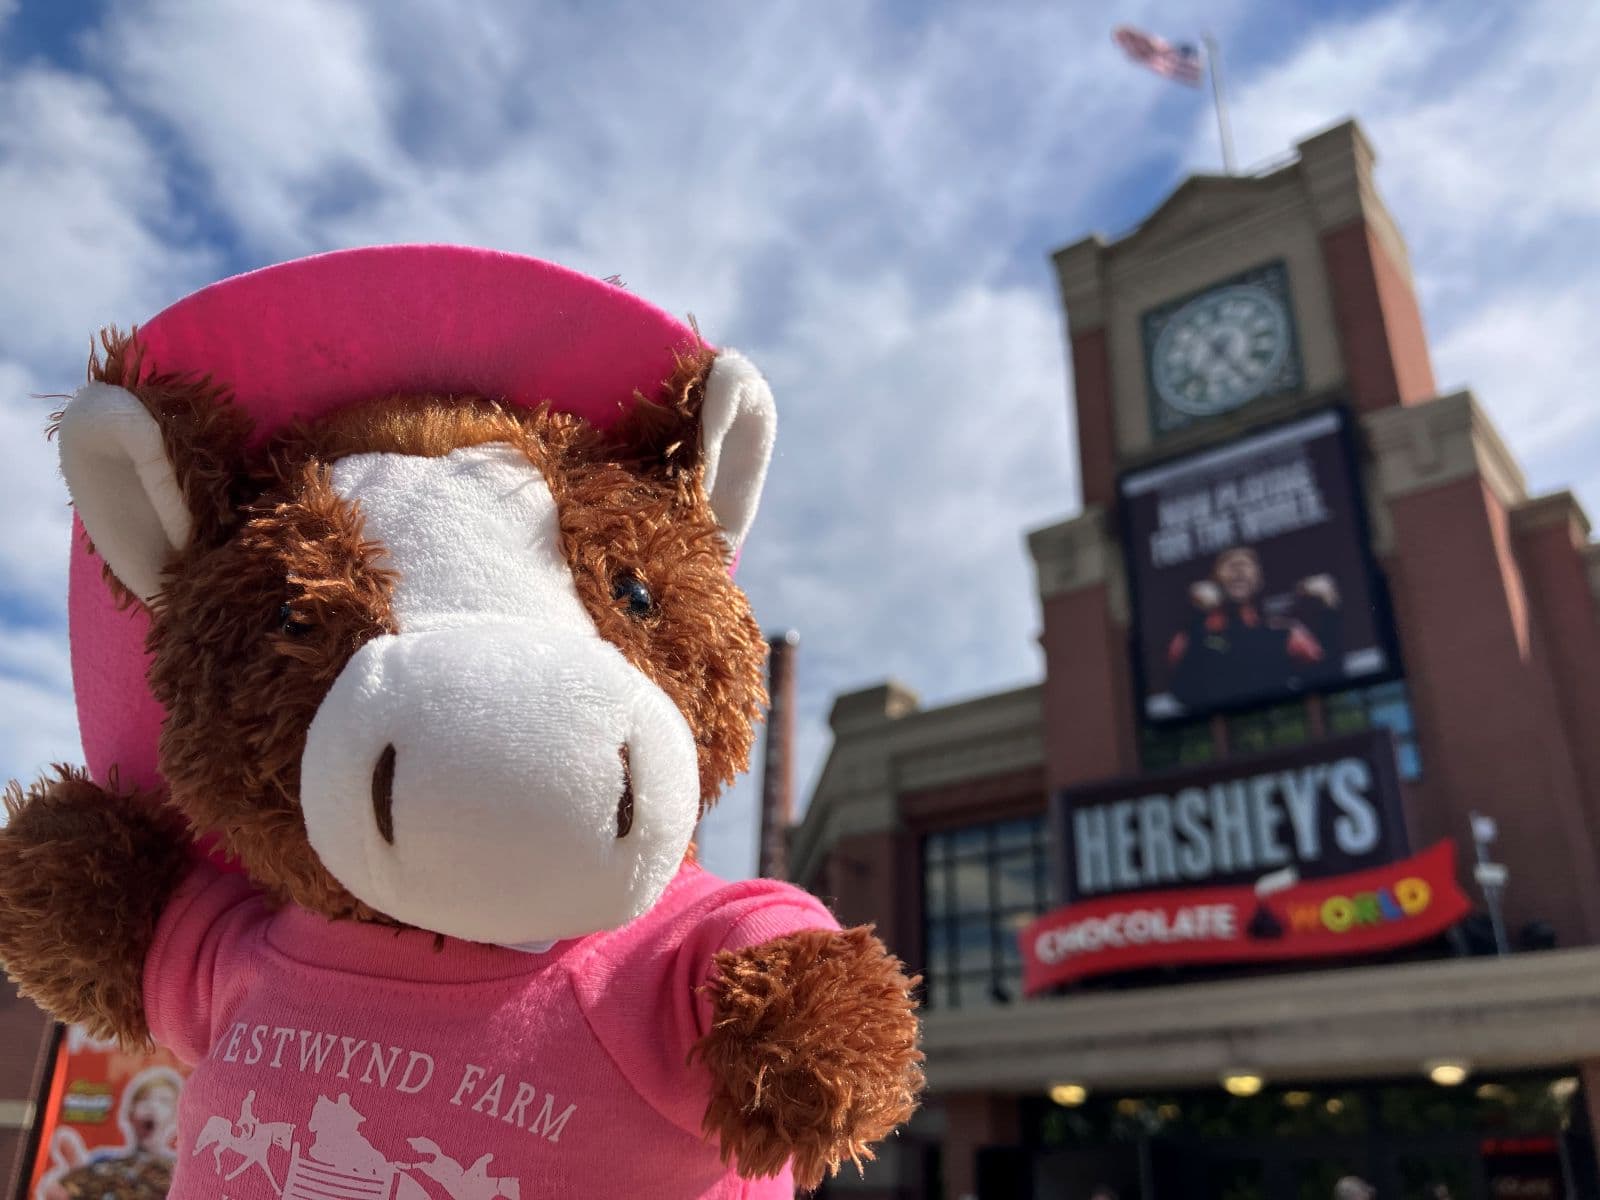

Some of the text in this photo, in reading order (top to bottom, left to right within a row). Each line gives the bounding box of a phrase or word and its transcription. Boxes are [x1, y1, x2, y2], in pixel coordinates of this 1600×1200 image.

[1072, 757, 1380, 894] HERSHEY'S
[1034, 903, 1237, 964] CHOCOLATE
[449, 1063, 578, 1143] FARM
